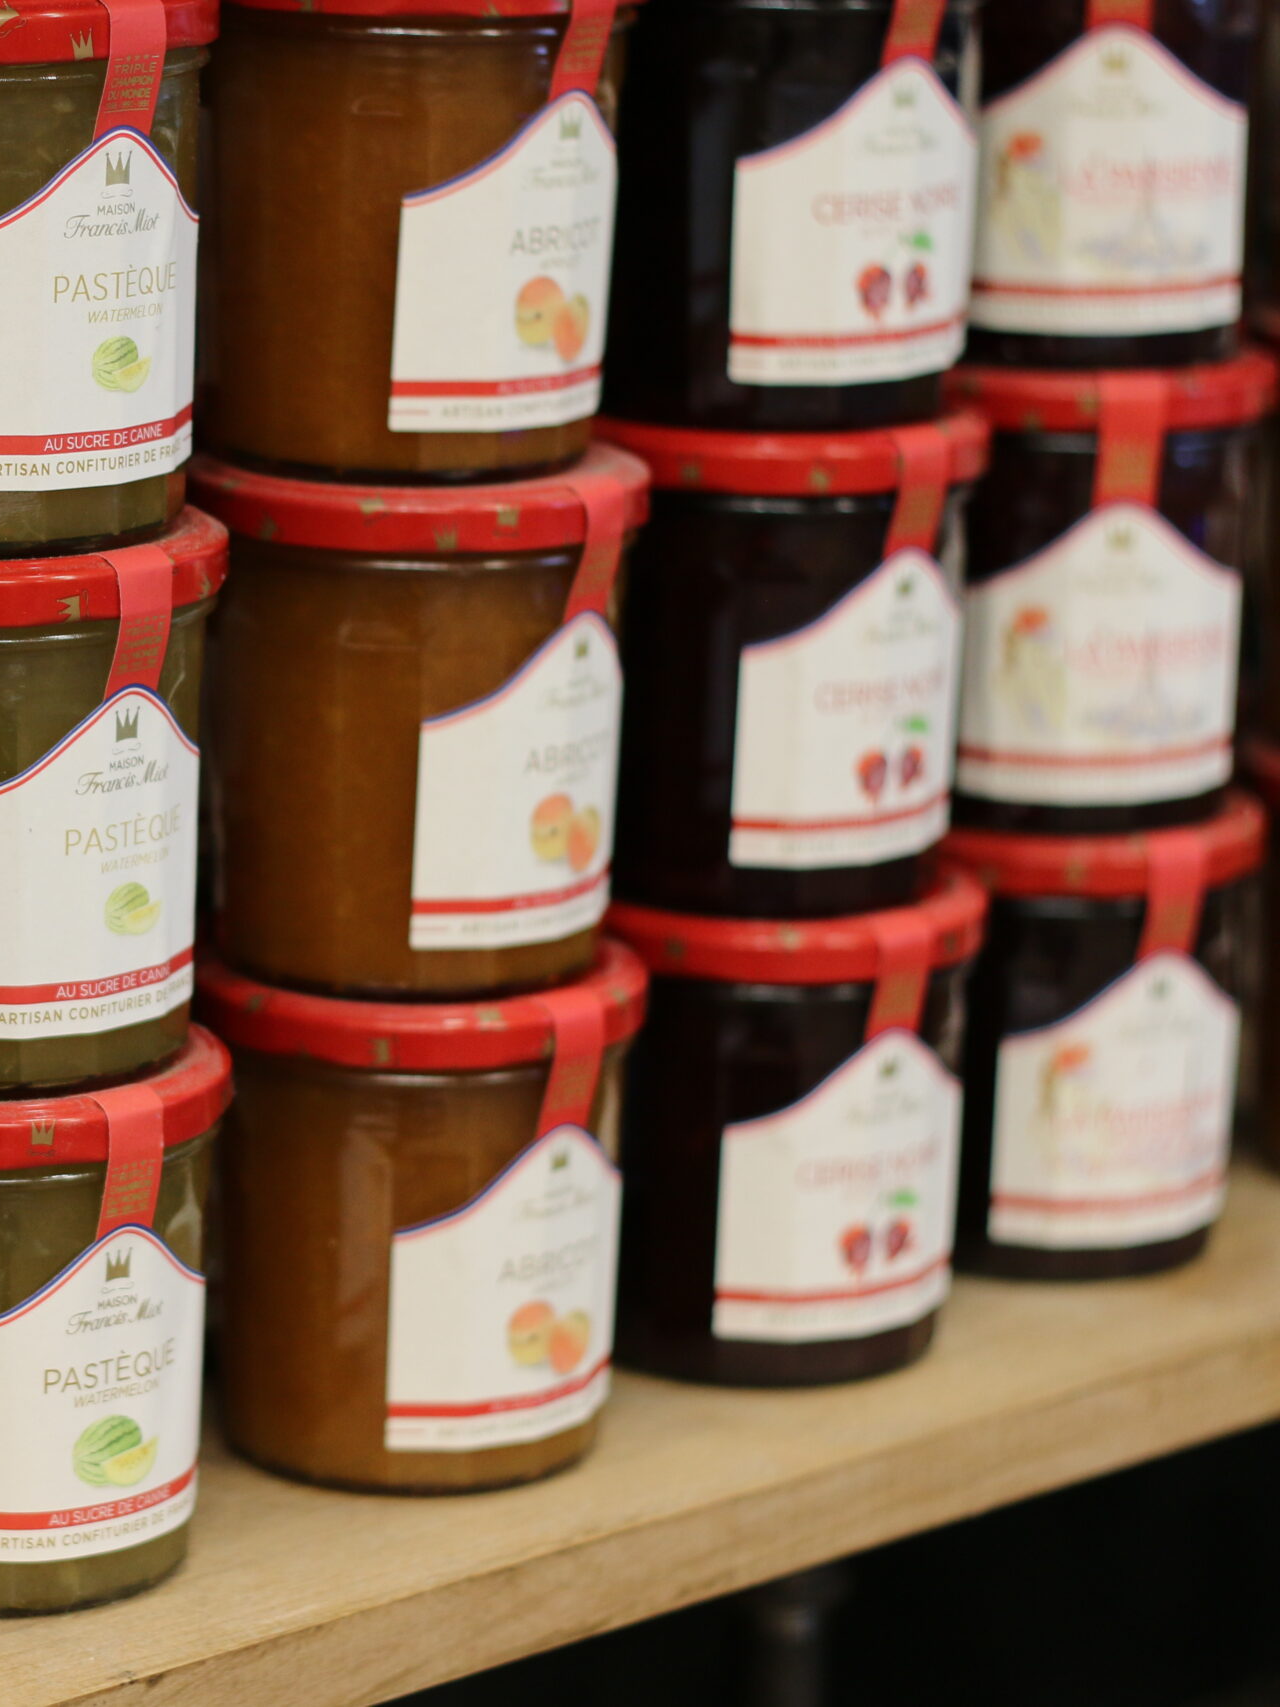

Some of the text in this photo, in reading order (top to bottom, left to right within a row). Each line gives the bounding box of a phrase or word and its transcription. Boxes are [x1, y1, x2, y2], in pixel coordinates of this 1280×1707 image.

[114, 62, 157, 75] TRIPLE
[97, 202, 136, 217] MAISON
[63, 208, 160, 239] Francis Miot
[53, 262, 177, 304] PASTÈQUE
[87, 302, 163, 324] WATERMELON
[44, 423, 163, 452] AU SUCRE DE CANNE
[56, 451, 141, 475] CONFITURIER
[144, 449, 157, 464] DE
[109, 756, 144, 772] MAISON
[75, 771, 135, 795] Francis
[65, 803, 181, 856] PASTÈQUE
[56, 985, 76, 998] AU
[80, 978, 120, 998] SUCRE
[122, 973, 137, 989] DE
[69, 994, 152, 1020] CONFITURIER
[97, 1294, 138, 1311] MAISON
[66, 1310, 127, 1335] Francis
[44, 1337, 175, 1394] PASTÈQUE
[74, 1377, 160, 1408] WATERMELON
[49, 1513, 69, 1527] AU
[72, 1505, 115, 1524] SUCRE
[118, 1498, 134, 1515] DE
[62, 1516, 148, 1545] CONFITURIER
